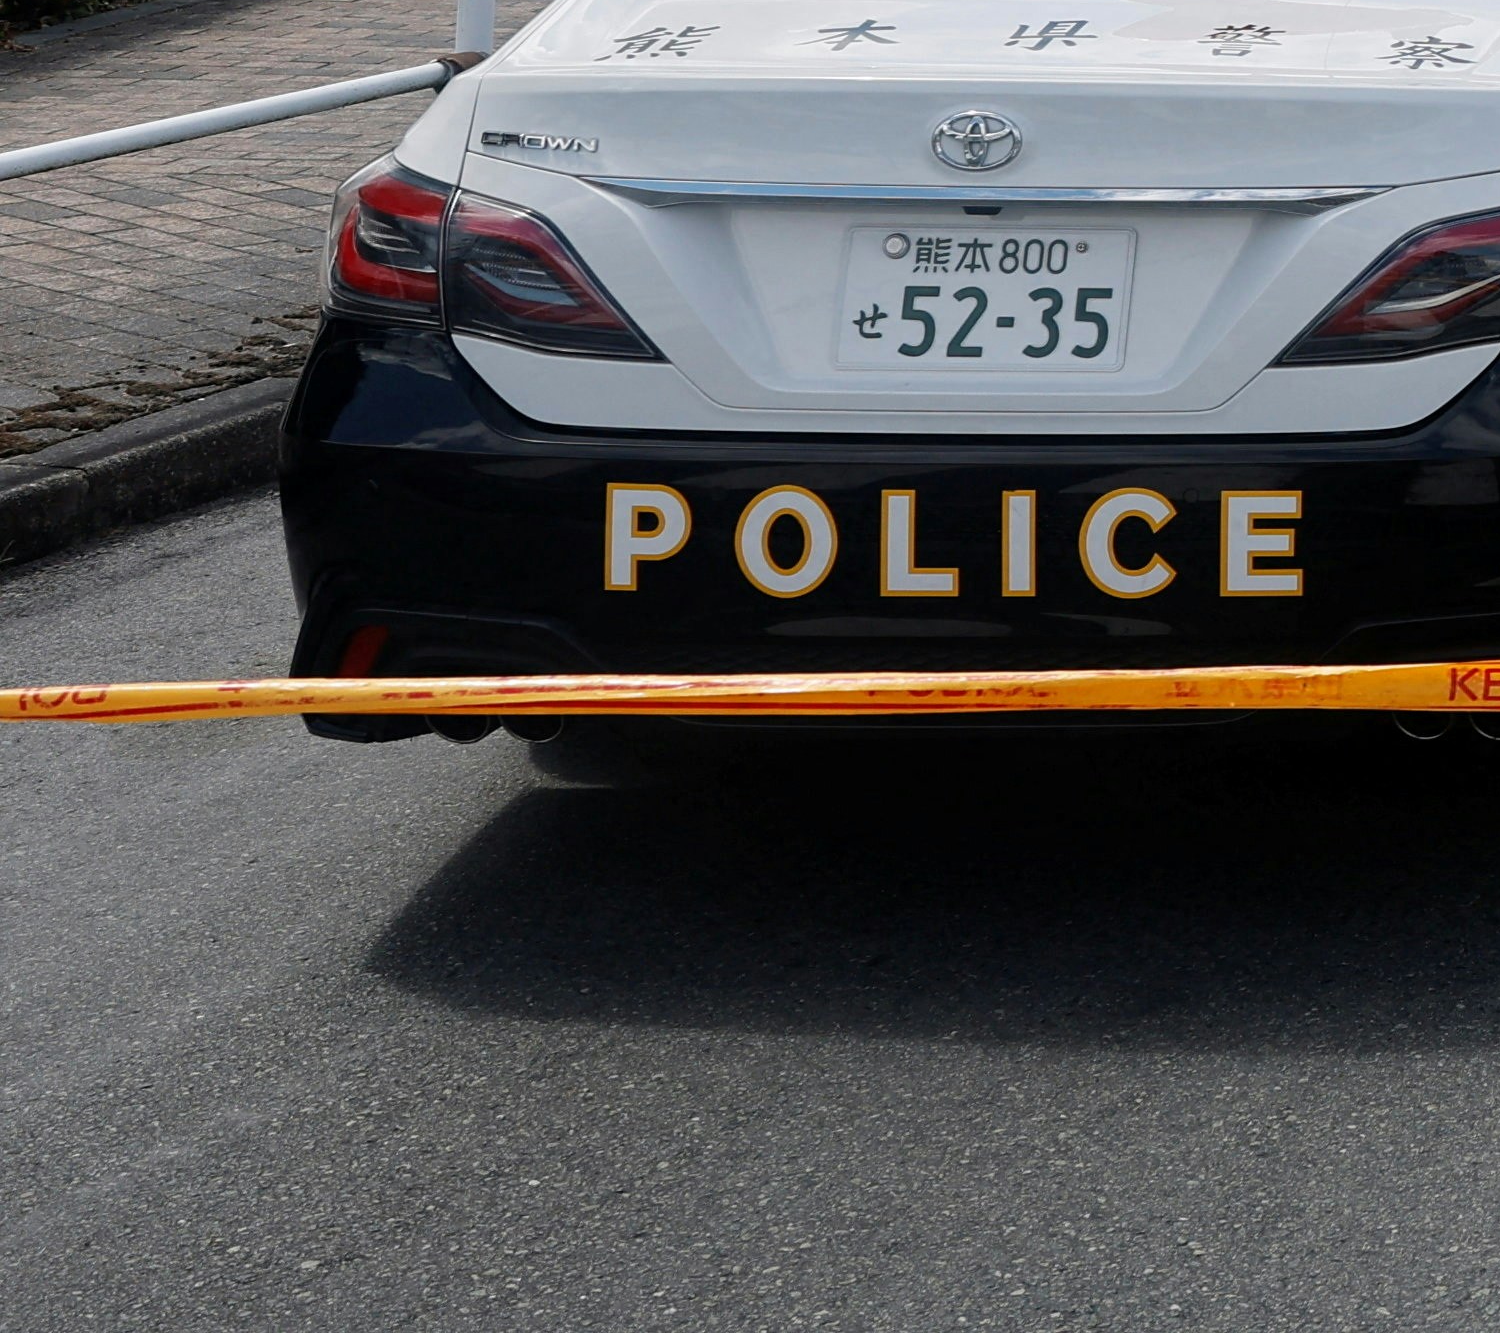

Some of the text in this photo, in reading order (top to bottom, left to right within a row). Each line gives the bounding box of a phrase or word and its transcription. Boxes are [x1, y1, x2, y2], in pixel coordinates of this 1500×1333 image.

[592, 18, 1478, 71] 熊本県警察
[481, 131, 599, 153] CROWN
[897, 285, 1114, 359] 52-35
[604, 482, 1304, 599] POLICE
